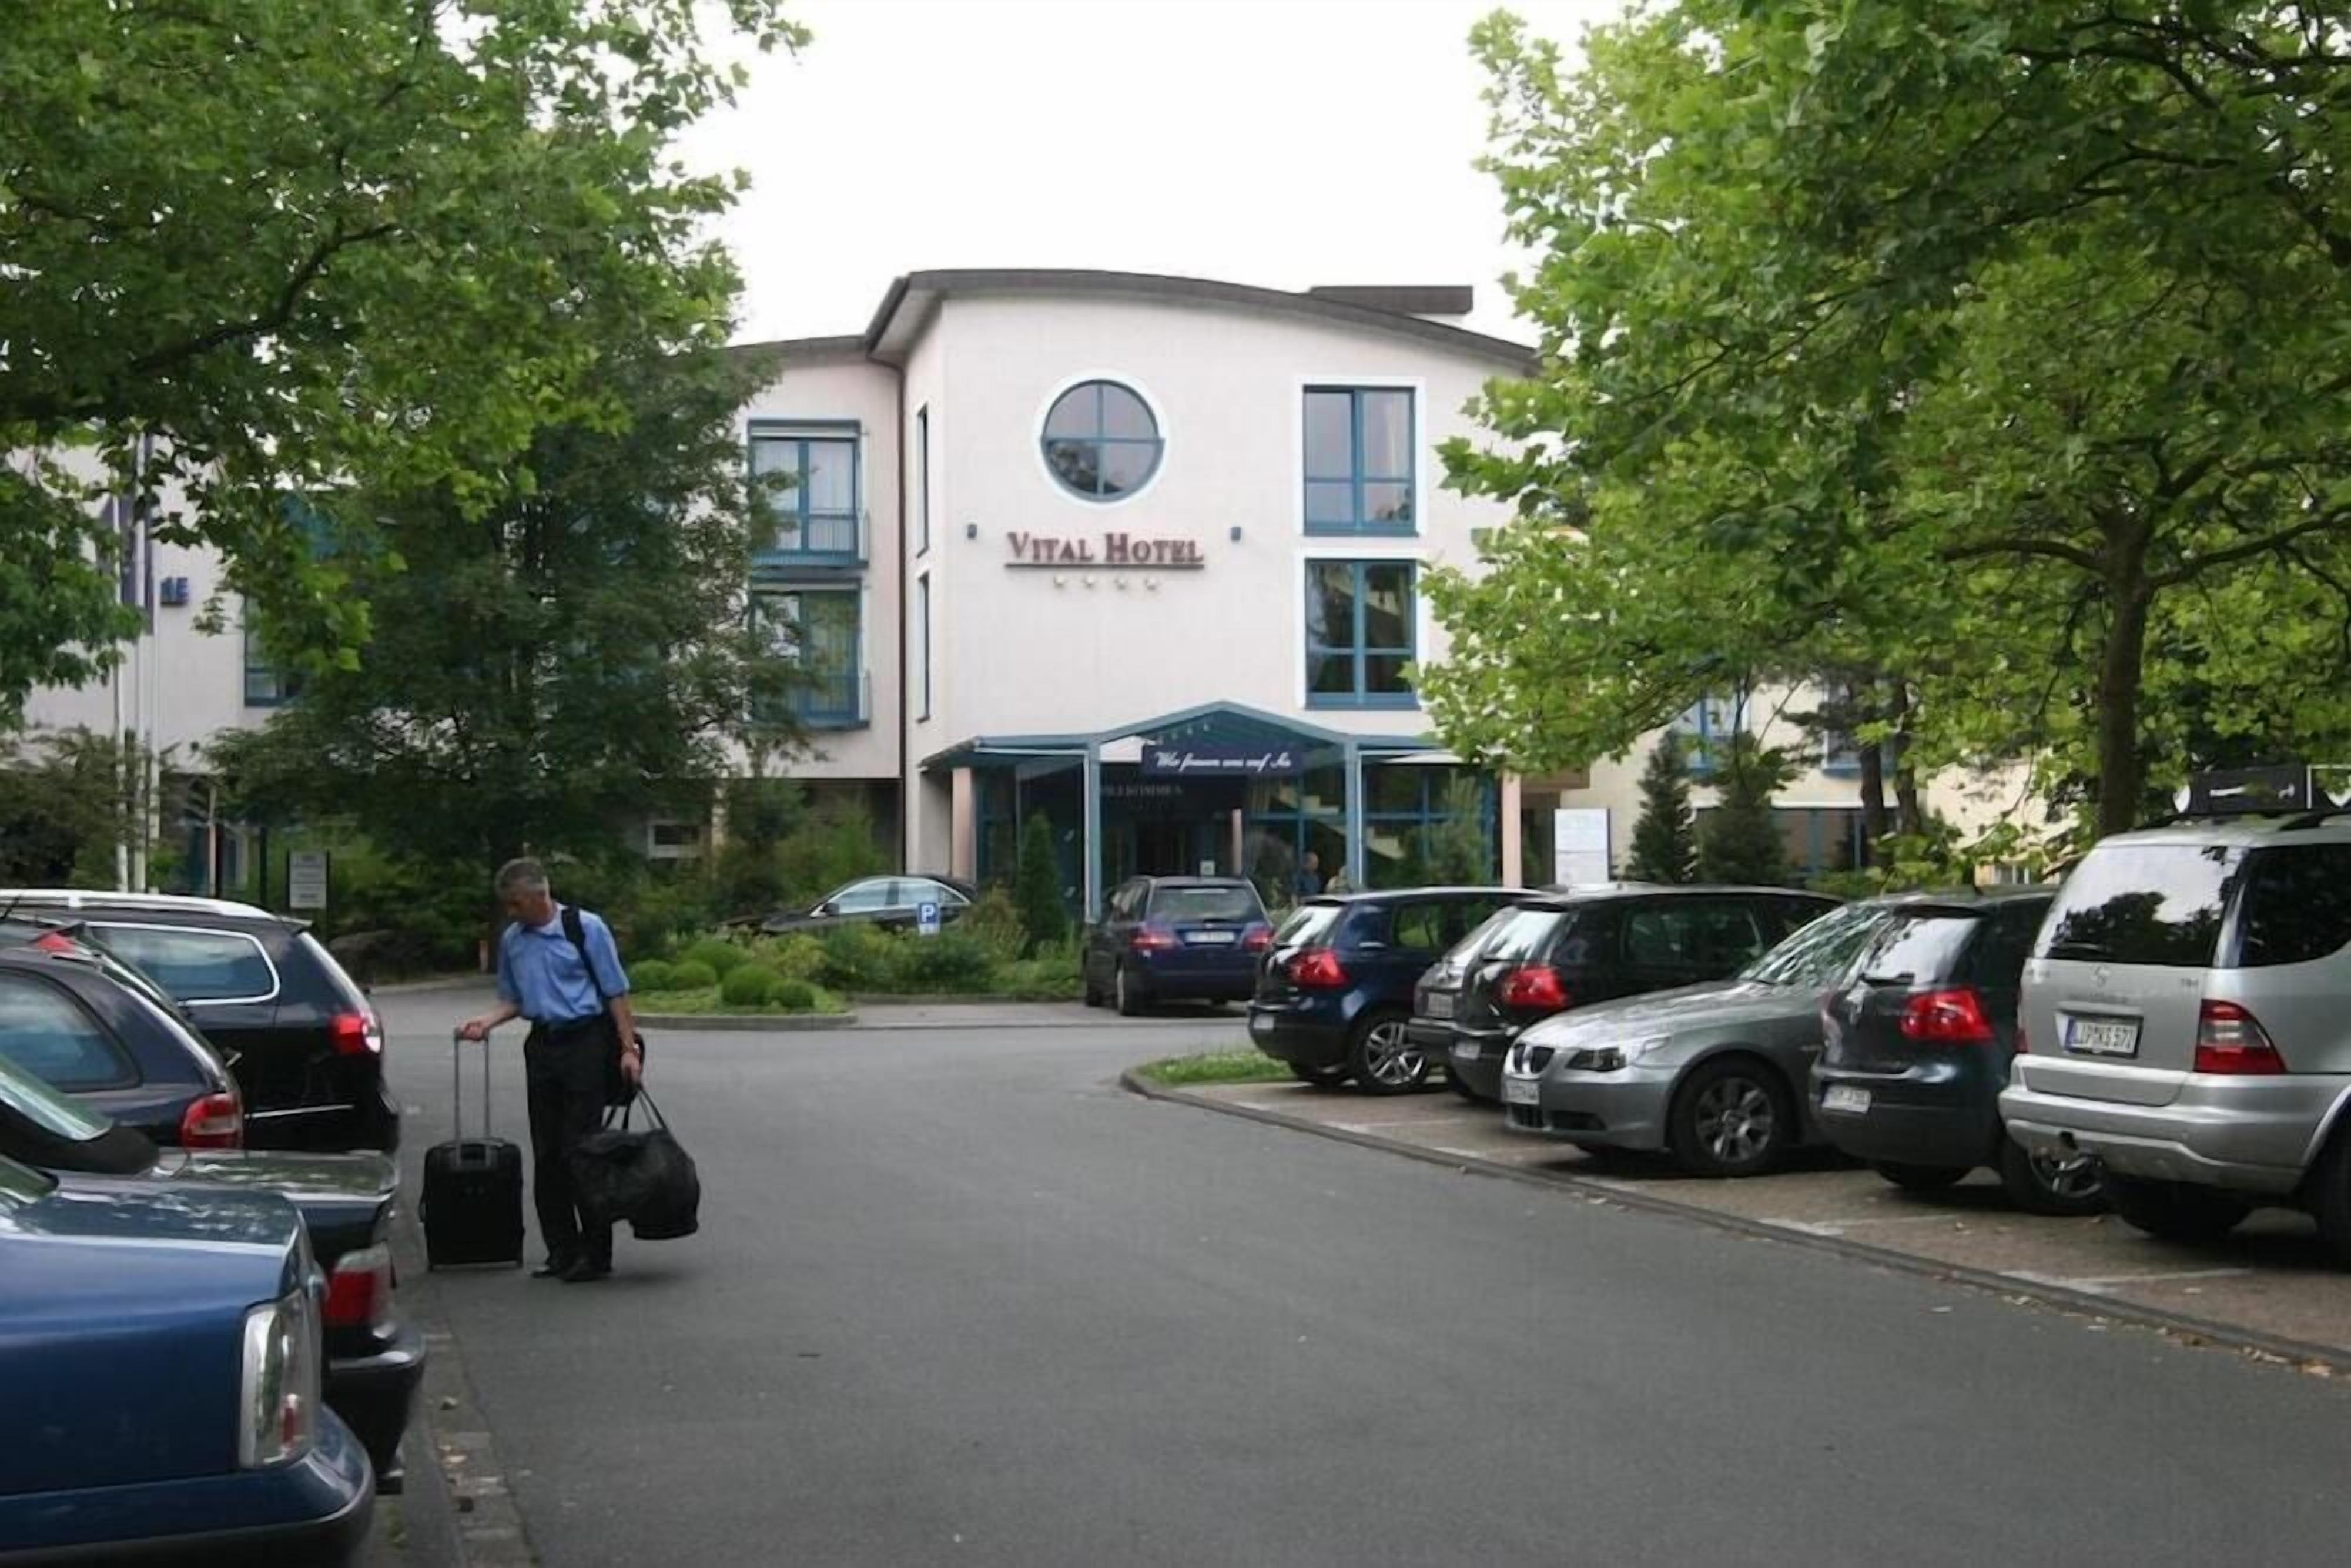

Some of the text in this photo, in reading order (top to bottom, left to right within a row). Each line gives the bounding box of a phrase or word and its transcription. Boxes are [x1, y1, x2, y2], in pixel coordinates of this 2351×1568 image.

[1007, 531, 1204, 562] VITAL HOTEL
[921, 904, 935, 922] P
